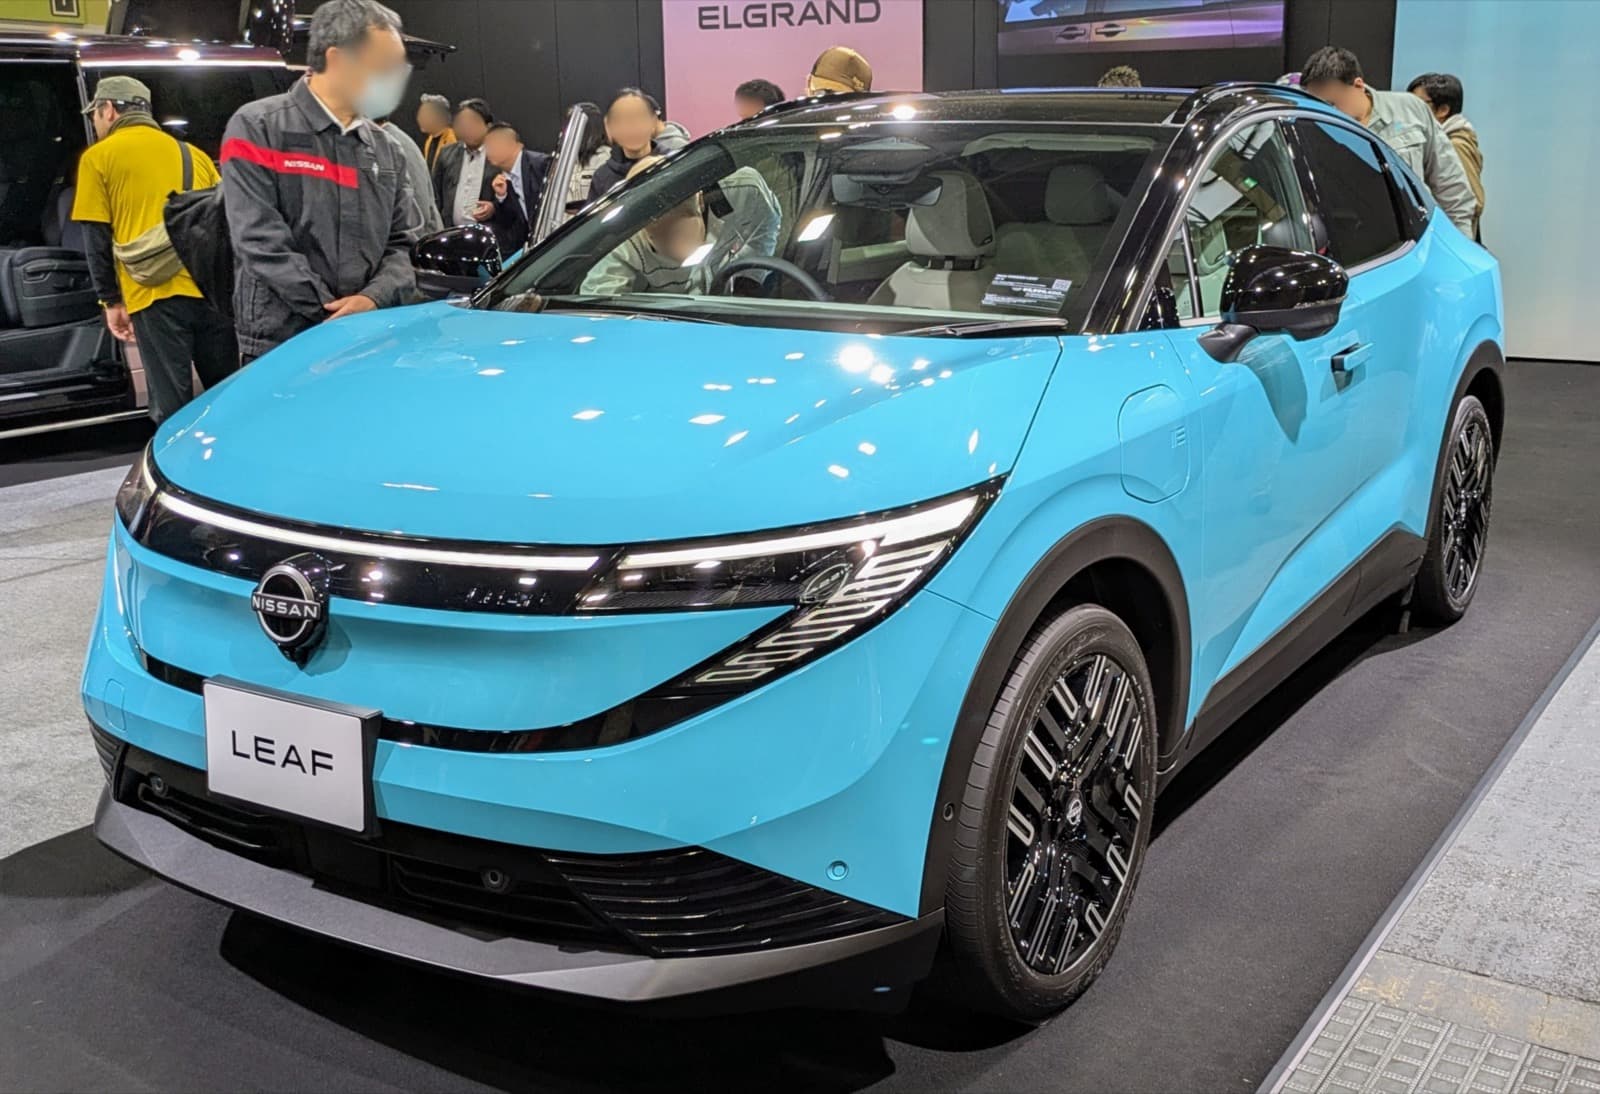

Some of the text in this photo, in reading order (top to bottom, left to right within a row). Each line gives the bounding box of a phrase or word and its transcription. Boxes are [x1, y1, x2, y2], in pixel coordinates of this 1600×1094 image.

[698, 0, 881, 30] ELGRAND
[283, 159, 325, 171] NISSAN
[252, 595, 318, 618] NISSAN
[232, 729, 333, 776] LEAF
